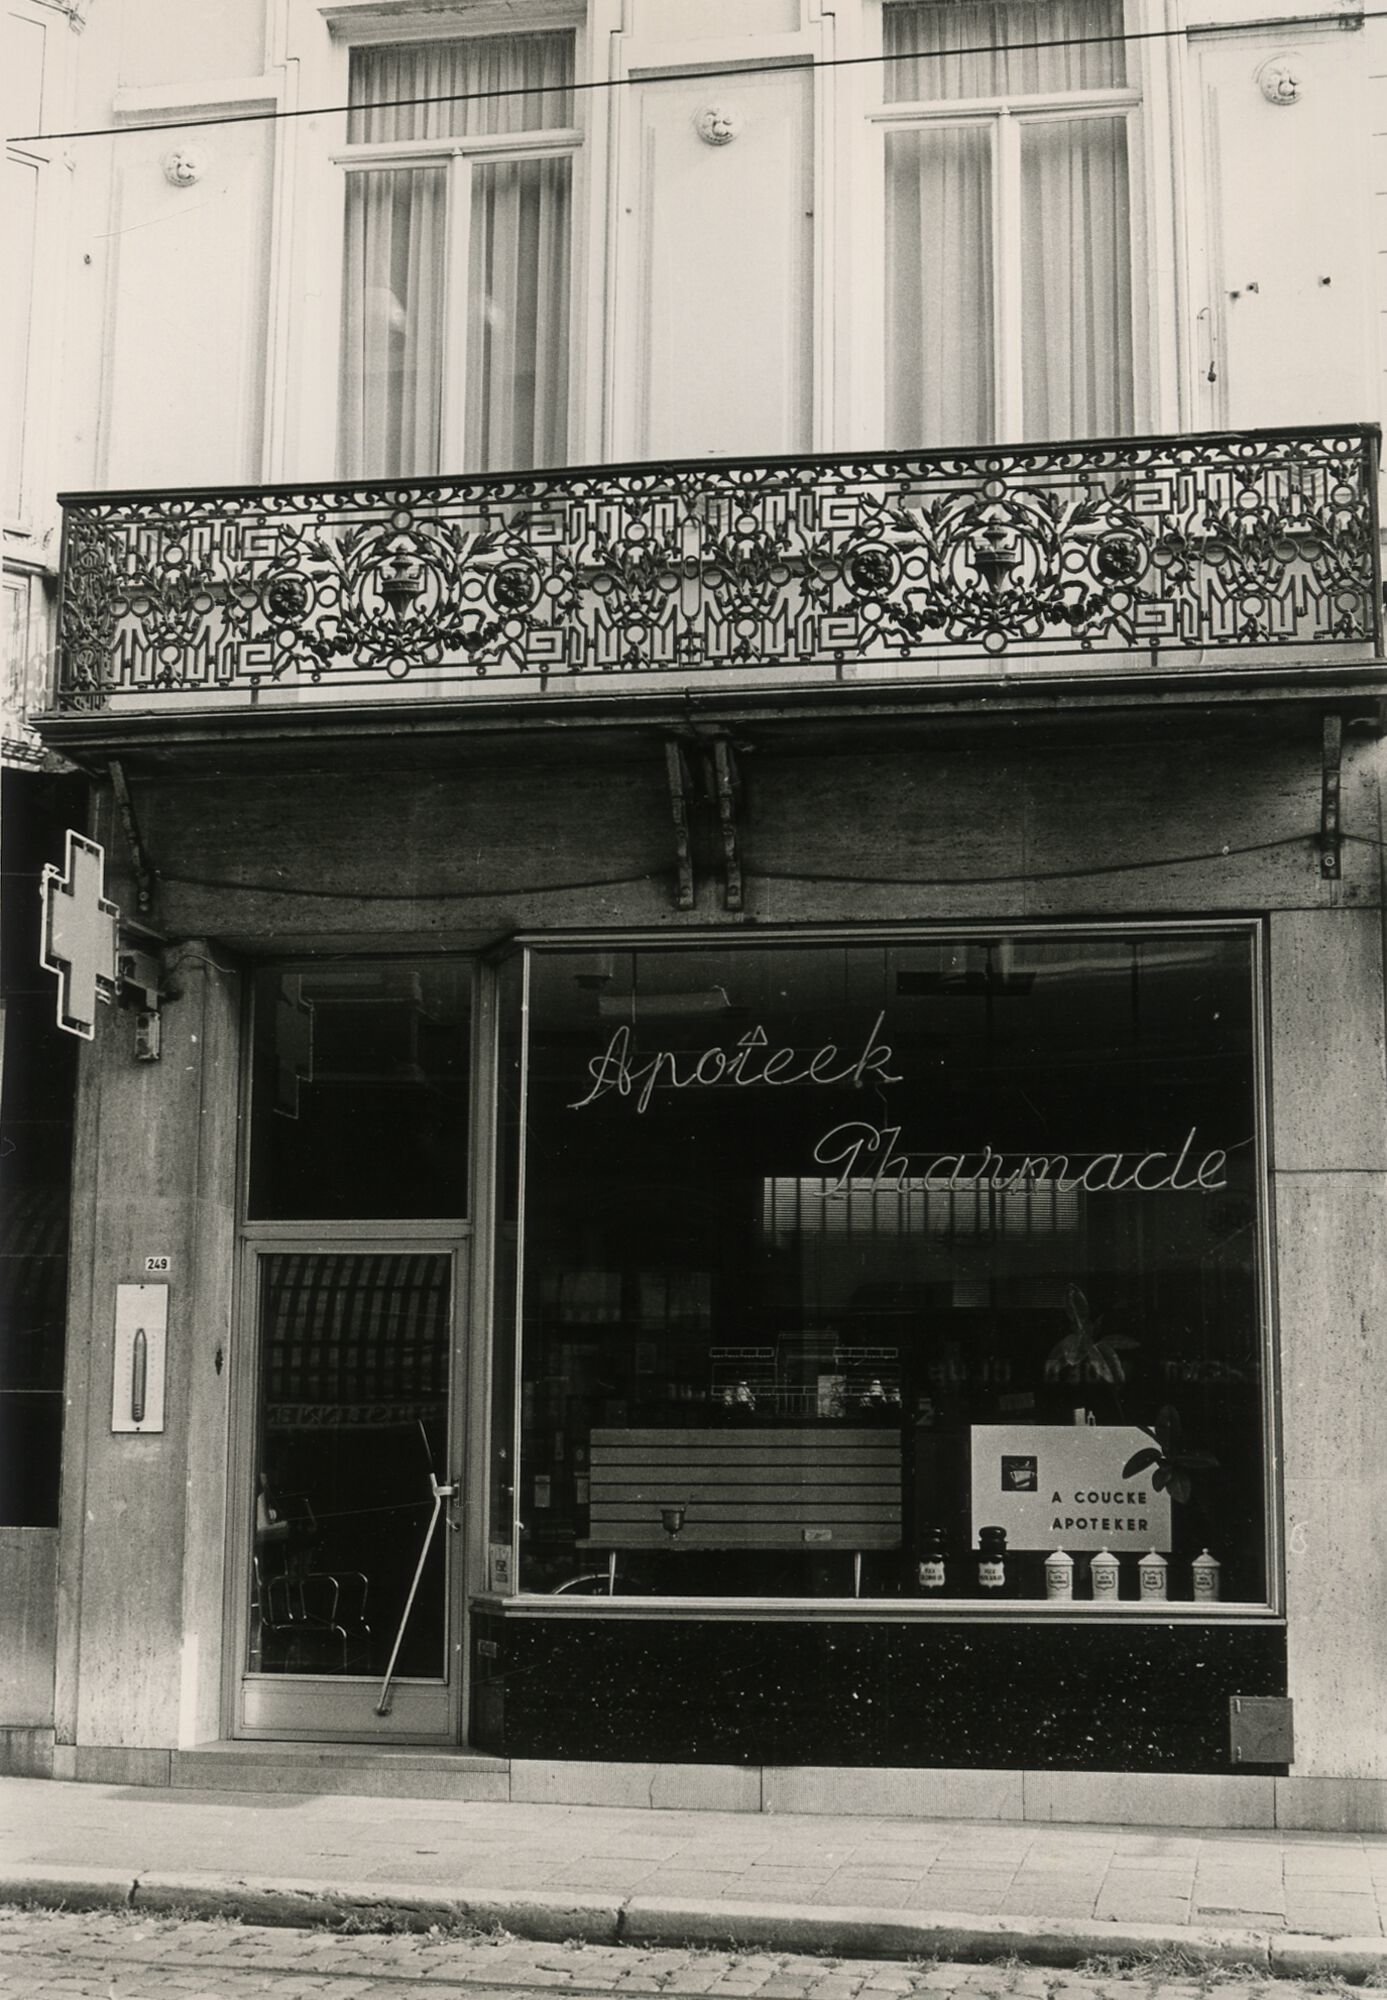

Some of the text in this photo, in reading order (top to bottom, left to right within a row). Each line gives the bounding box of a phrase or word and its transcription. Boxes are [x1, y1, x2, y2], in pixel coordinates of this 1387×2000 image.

[567, 1009, 904, 1114] Apoteek
[147, 1258, 168, 1270] 249
[1051, 1490, 1149, 1505] A COUCKE
[1052, 1516, 1150, 1532] APOTEKER
